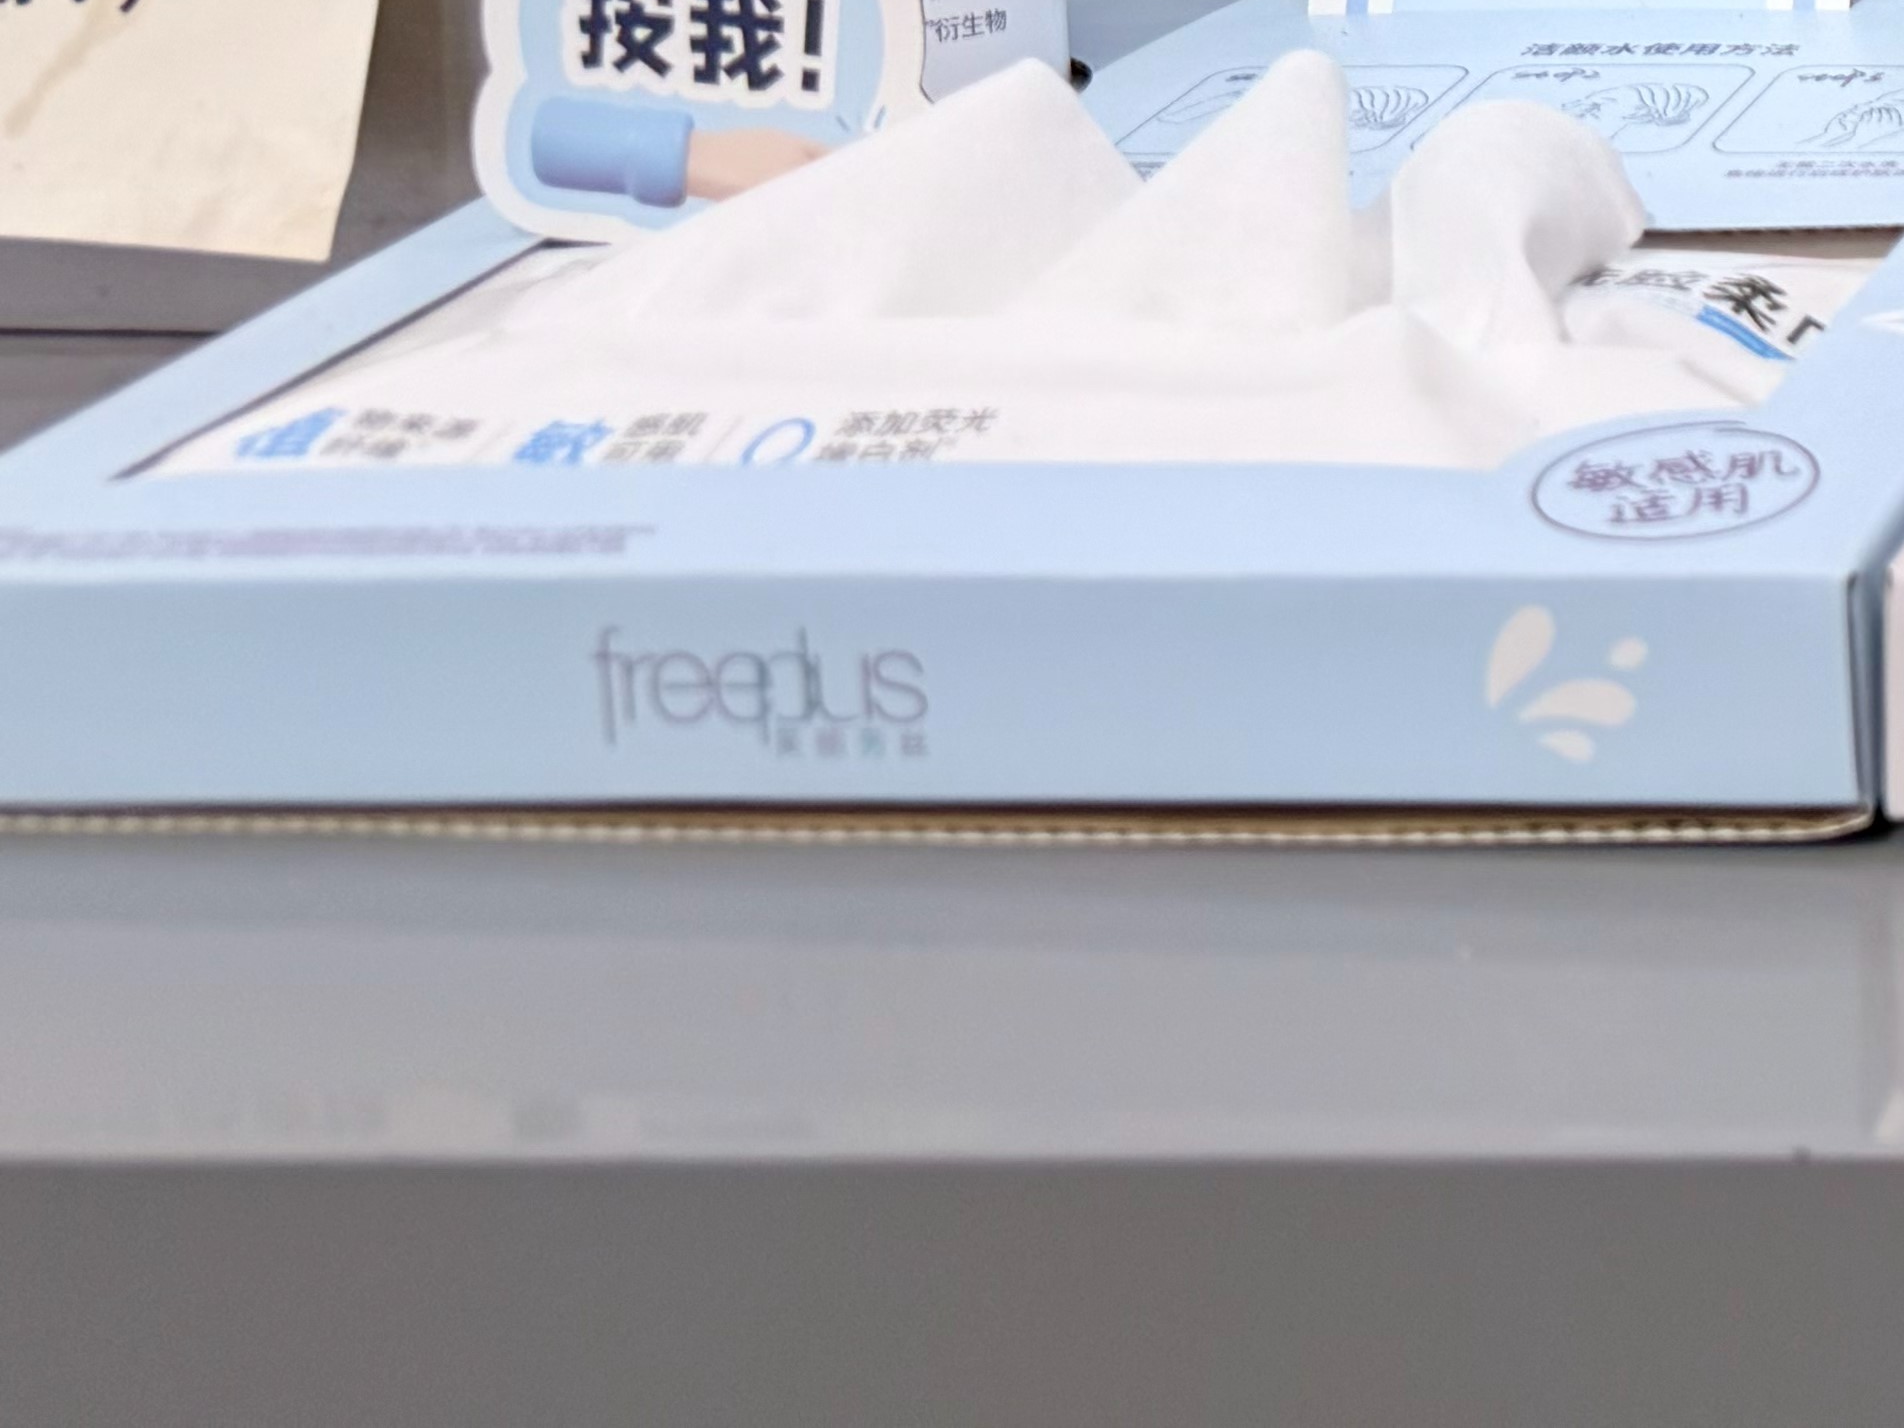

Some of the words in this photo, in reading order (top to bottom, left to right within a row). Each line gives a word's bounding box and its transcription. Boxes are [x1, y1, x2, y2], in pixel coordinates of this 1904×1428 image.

[1521, 42, 1800, 58] 洁颜水使用方法
[1570, 449, 1800, 493] 敏感肌
[1609, 484, 1749, 525] 适用
[592, 624, 928, 748] freeplus
